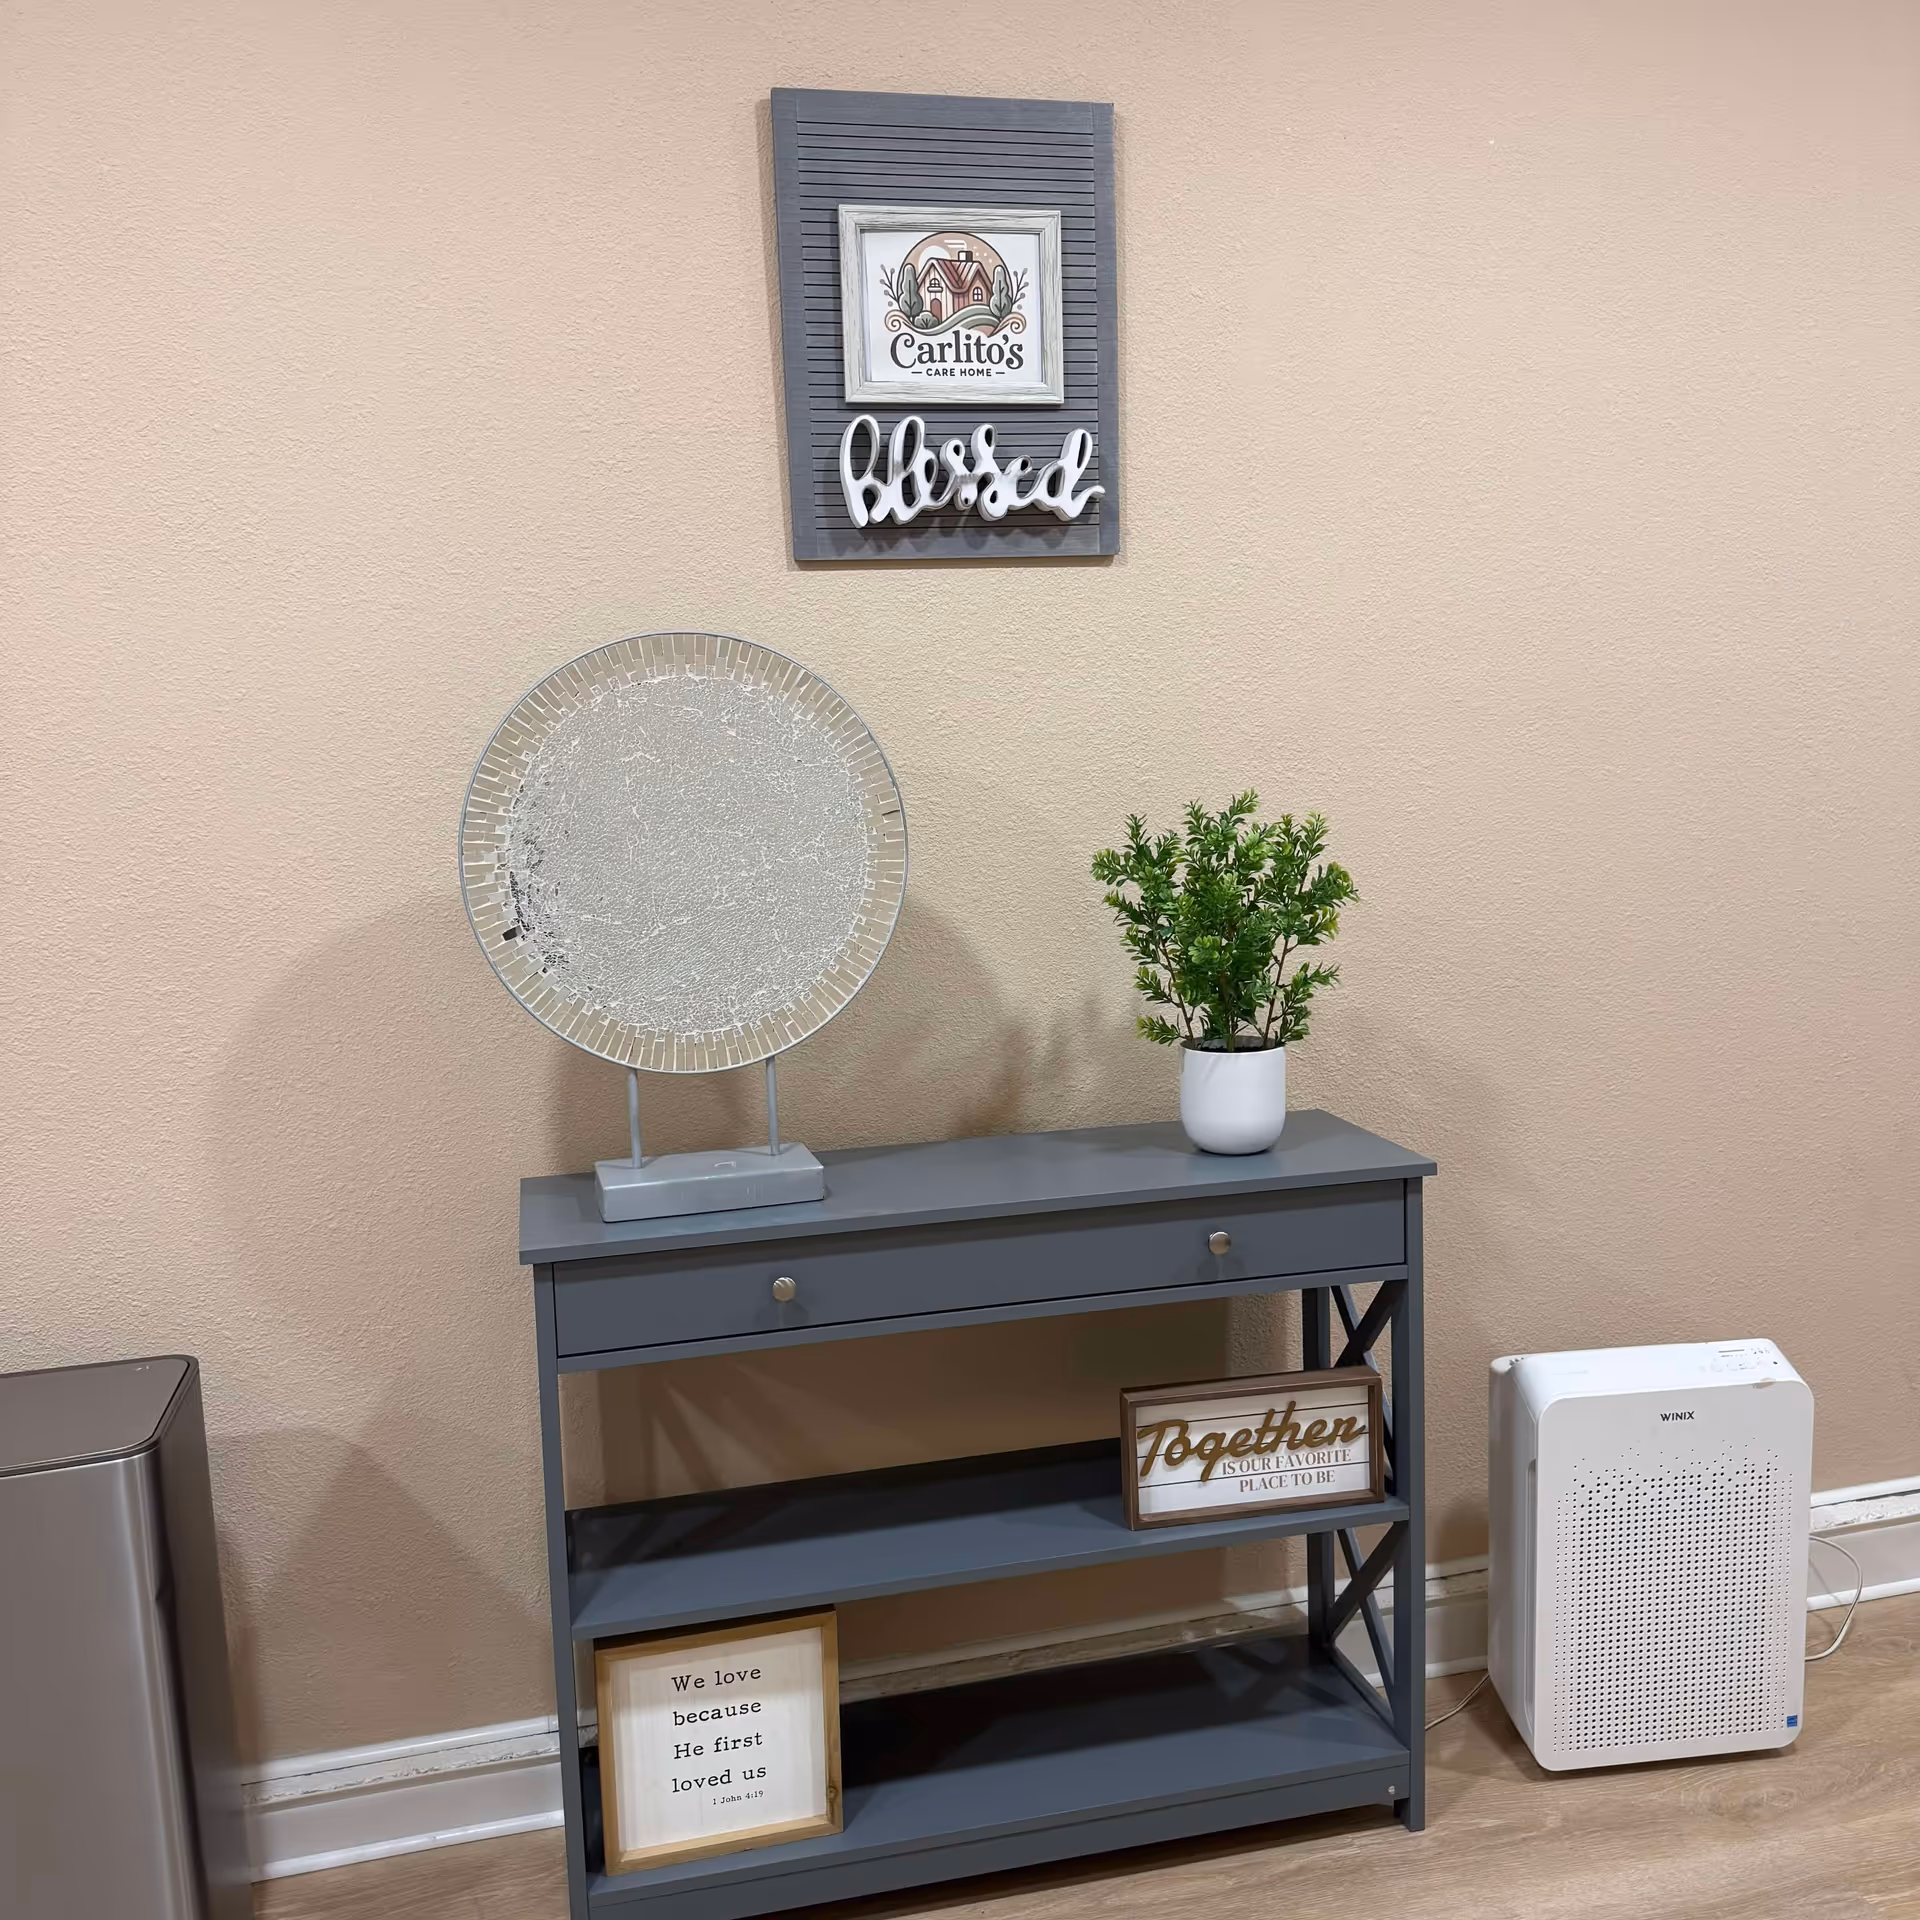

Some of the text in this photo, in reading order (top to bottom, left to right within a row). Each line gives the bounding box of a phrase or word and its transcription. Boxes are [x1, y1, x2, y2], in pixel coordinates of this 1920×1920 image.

[890, 330, 1024, 370] Carlito's
[925, 368, 992, 377] CARE HOME
[840, 414, 1105, 528] blessed
[1660, 1411, 1695, 1422] WINIX
[1137, 1401, 1366, 1482] Together
[1222, 1448, 1352, 1475] IS OUR FAVORITE
[1239, 1470, 1336, 1492] PLACE TO BE
[671, 1668, 762, 1692] We love
[673, 1701, 762, 1726] because
[673, 1732, 763, 1759] He first
[671, 1766, 767, 1793] loved us
[720, 1794, 742, 1804] John
[745, 1790, 764, 1800] 4:19
